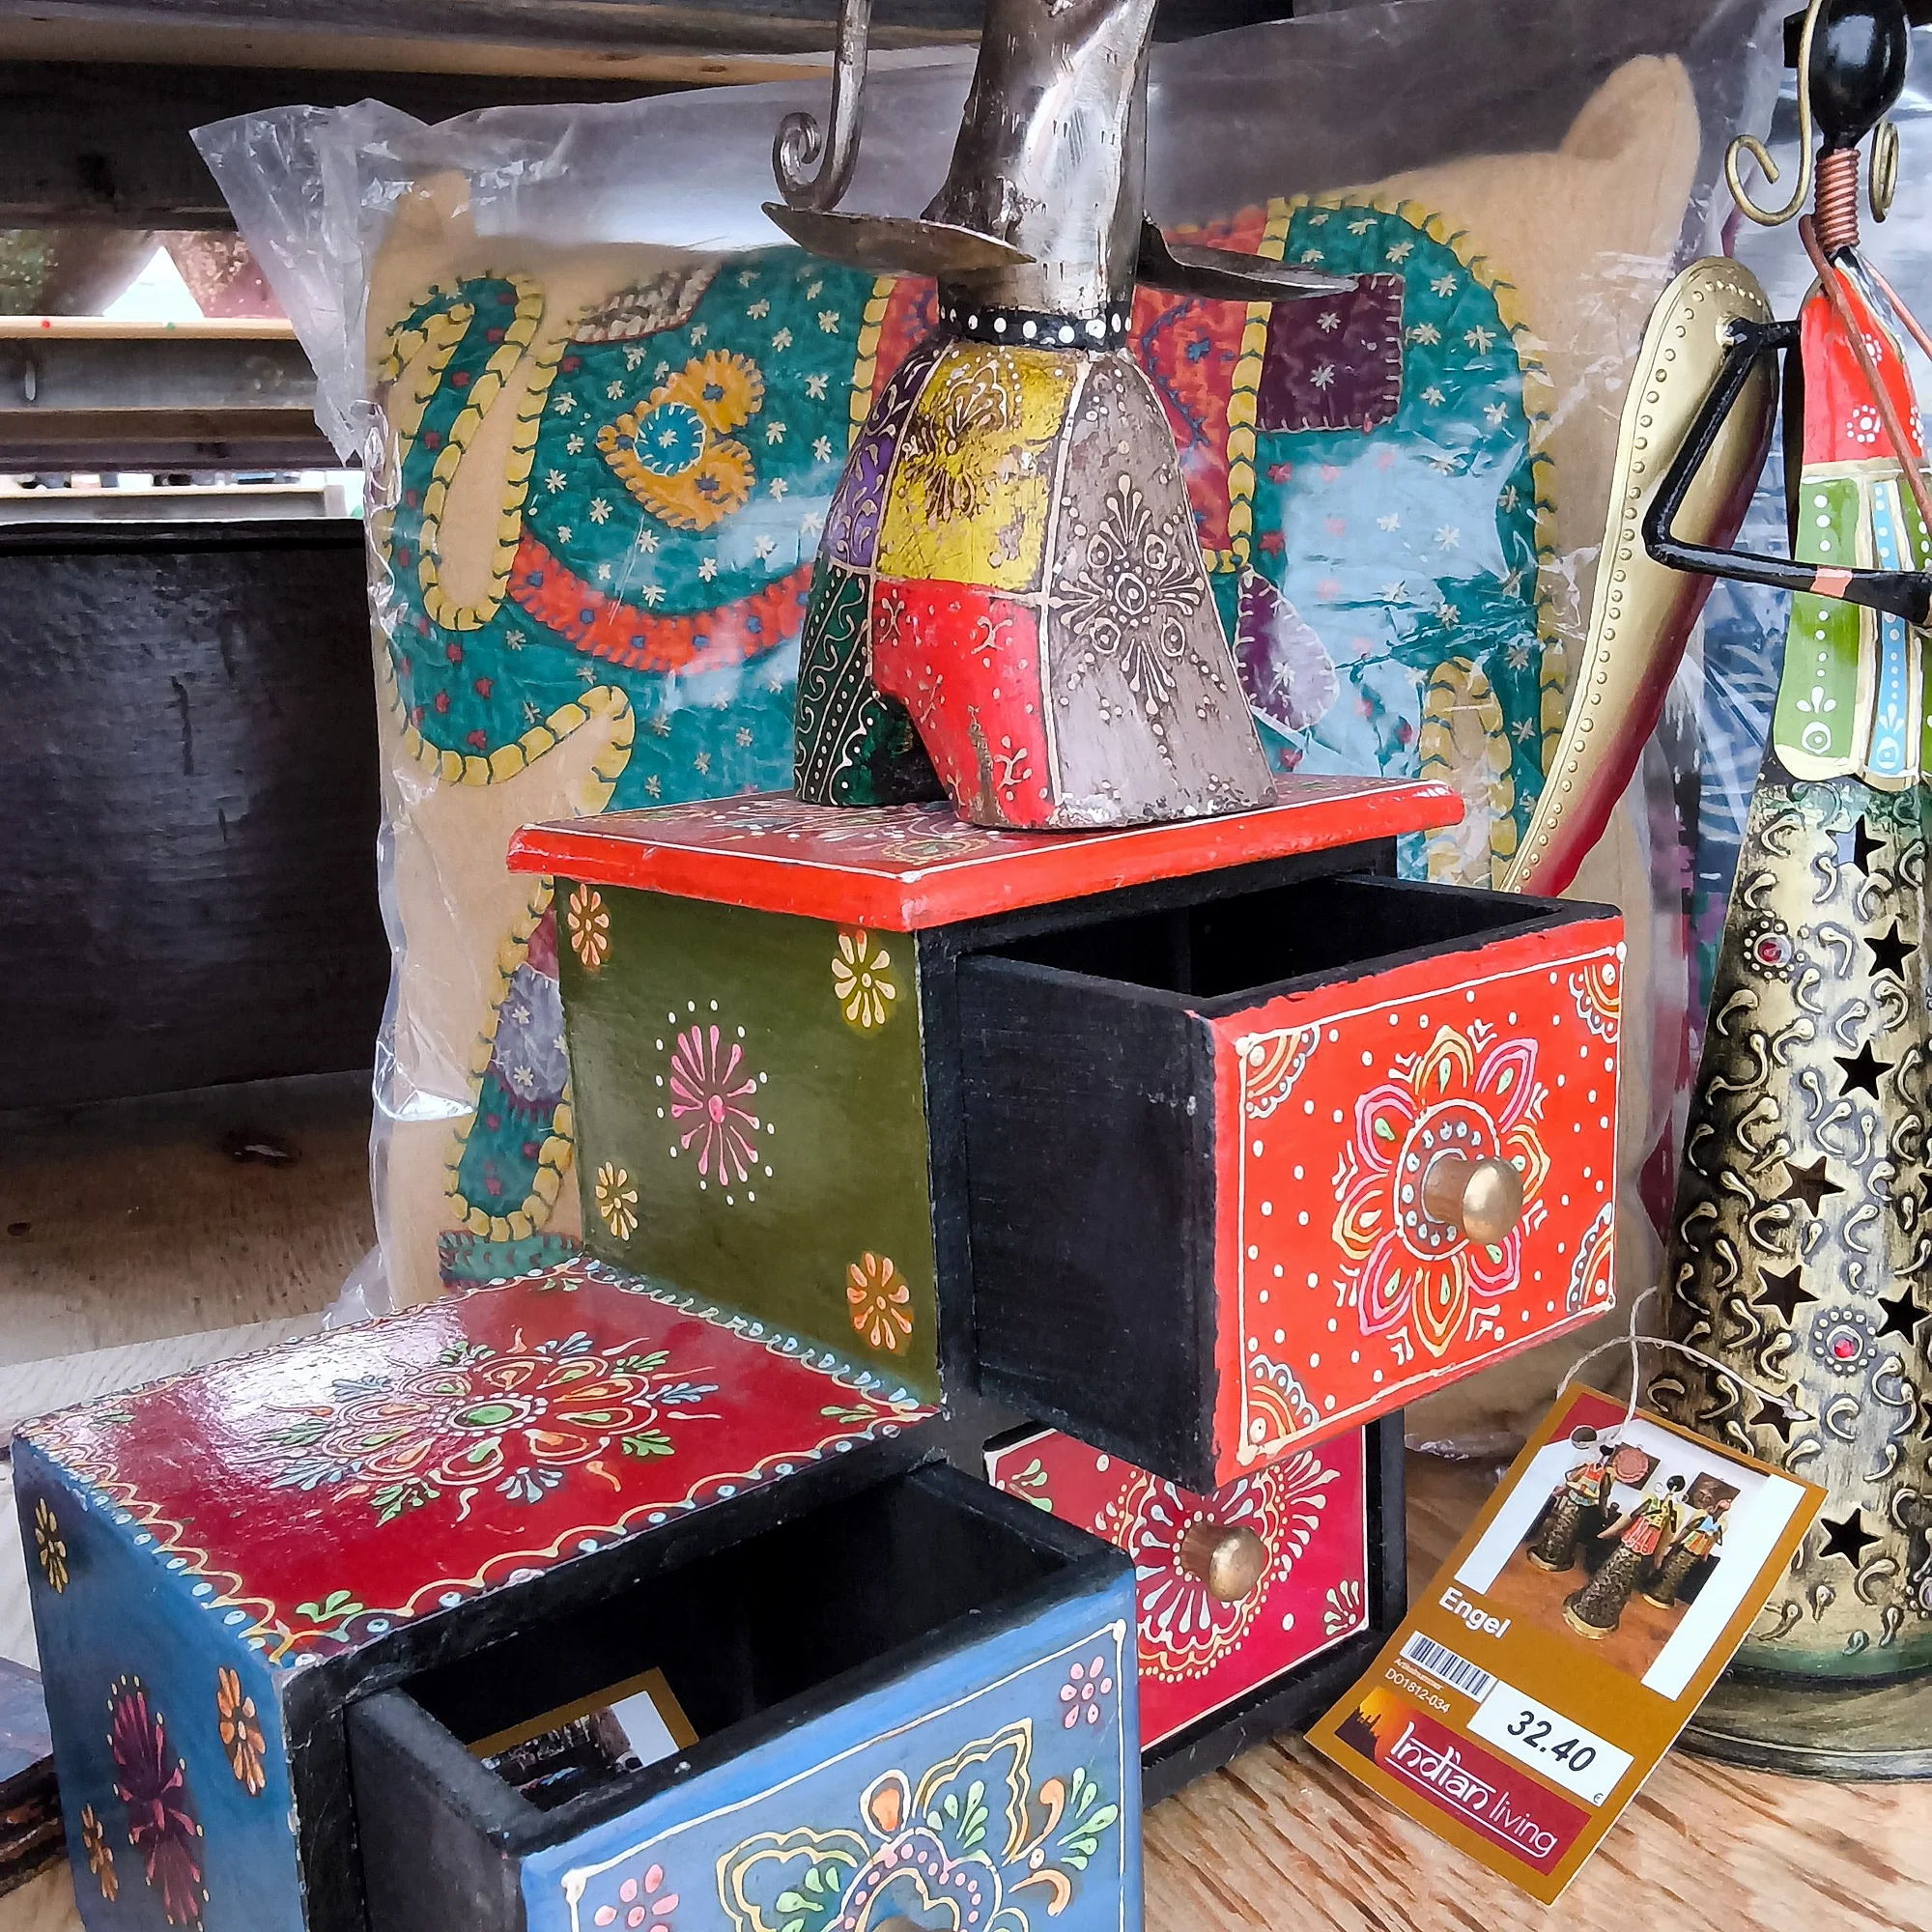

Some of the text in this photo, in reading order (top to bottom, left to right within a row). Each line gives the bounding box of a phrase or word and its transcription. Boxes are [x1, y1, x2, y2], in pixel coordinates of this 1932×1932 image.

[1438, 1586, 1511, 1638] Engel
[1507, 1710, 1596, 1772] 32.40
[1390, 1720, 1558, 1859] Indian living
